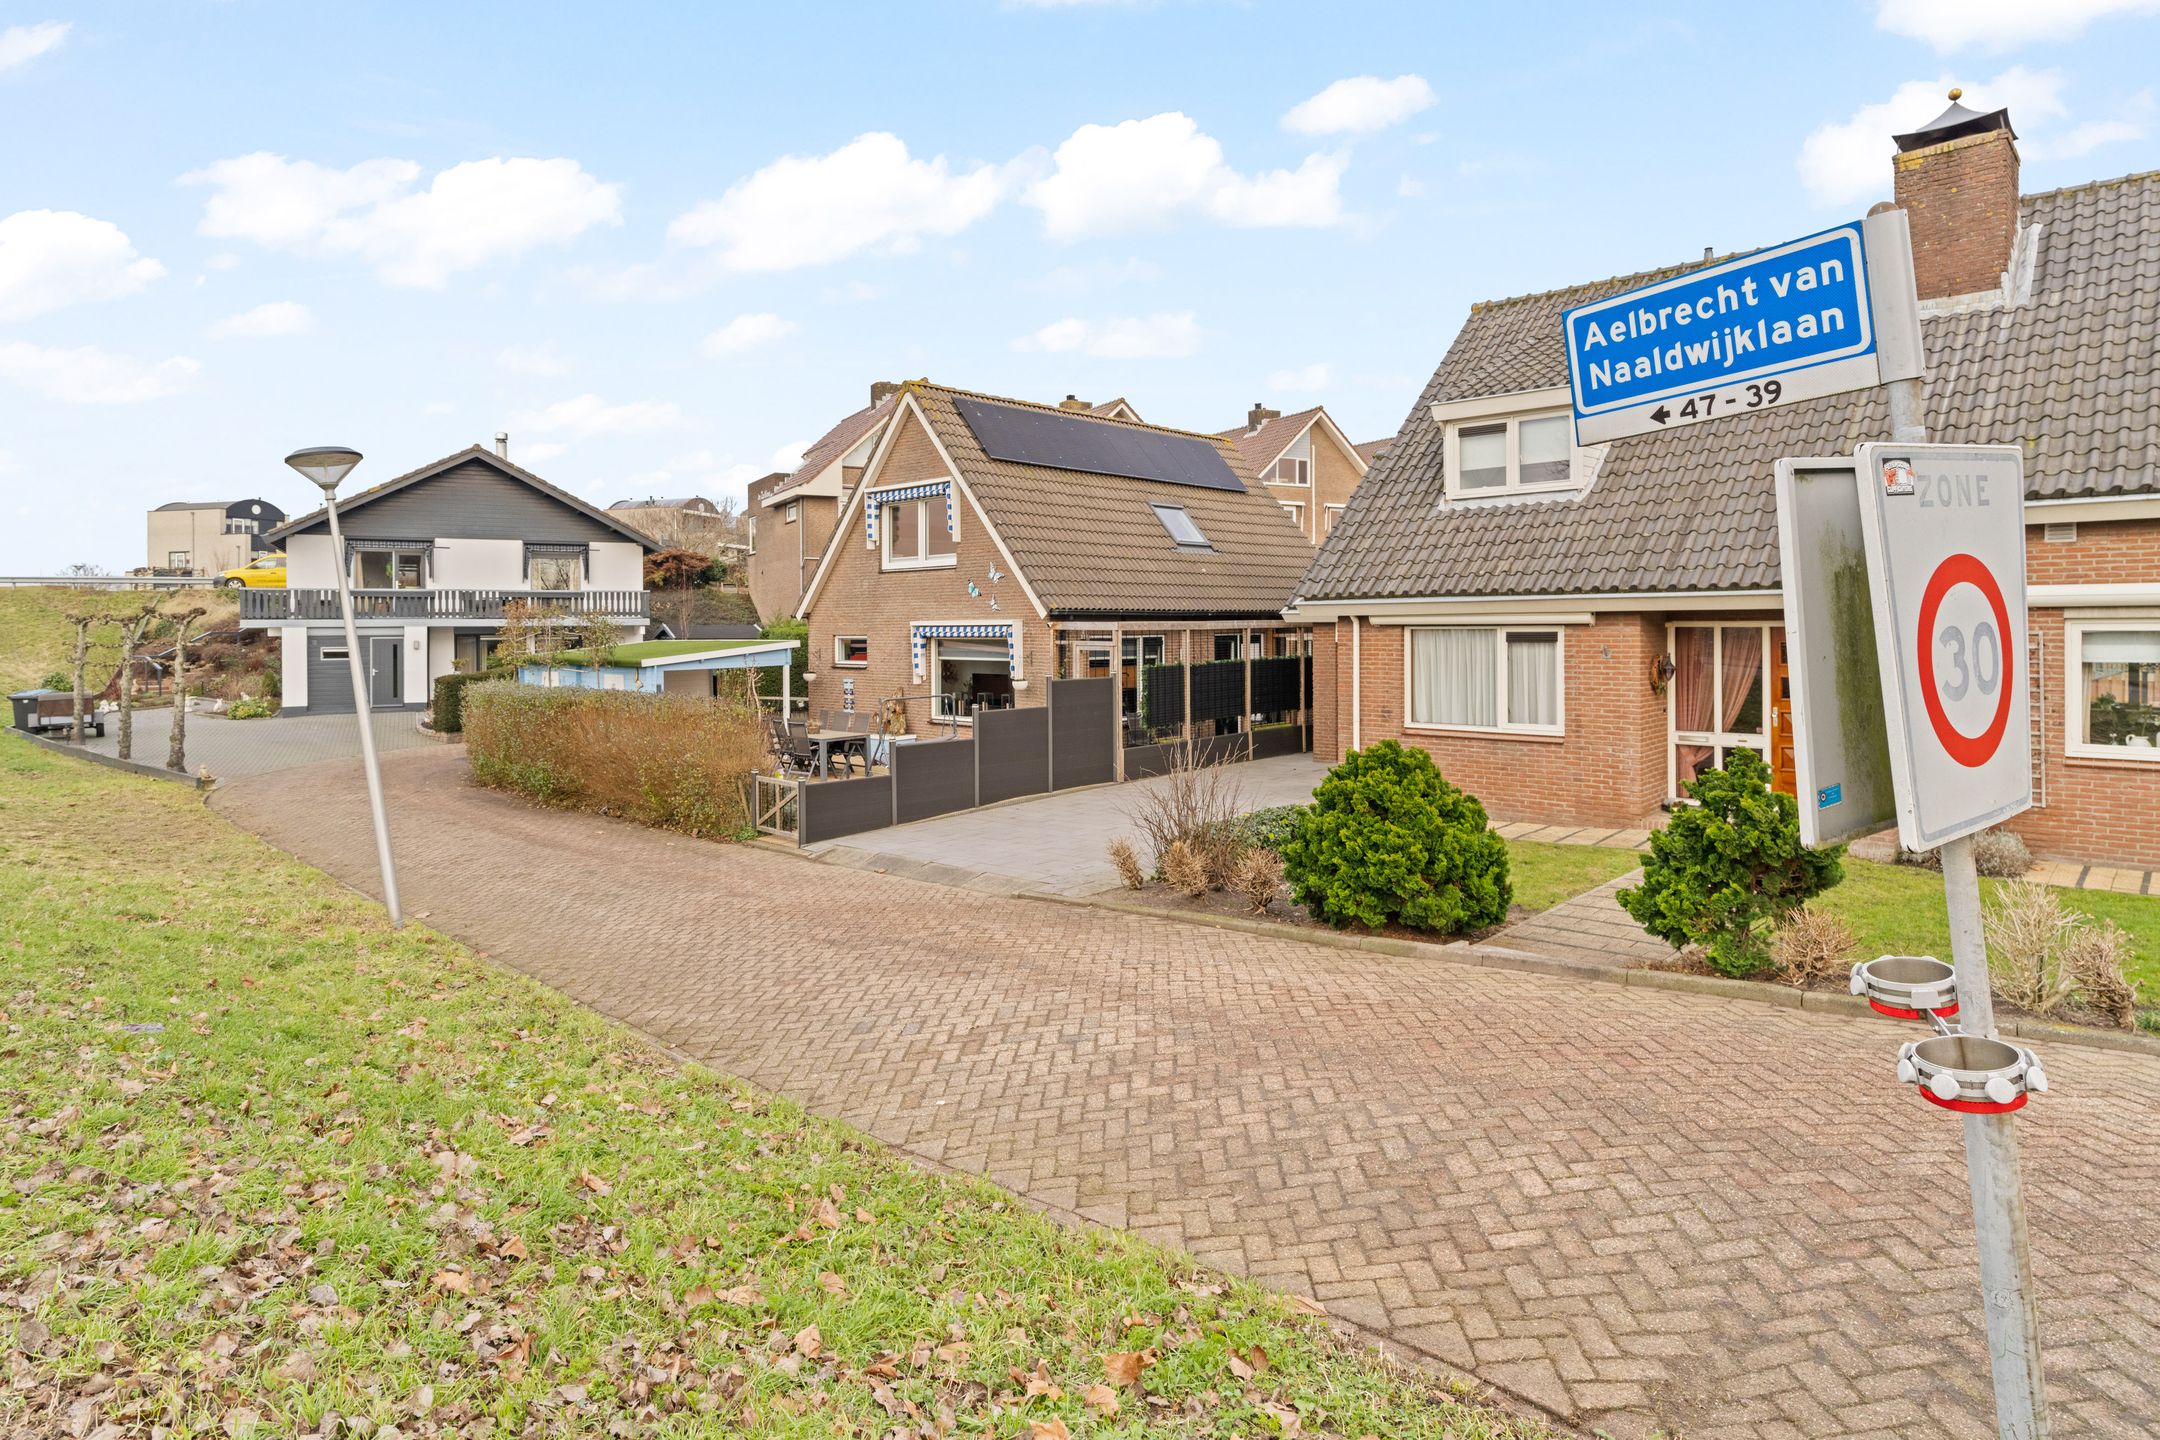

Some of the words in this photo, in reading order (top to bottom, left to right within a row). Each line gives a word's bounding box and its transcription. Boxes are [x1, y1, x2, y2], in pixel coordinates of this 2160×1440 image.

[1584, 276, 1759, 352] Aelbrecht
[1769, 259, 1844, 299] van
[1589, 307, 1845, 390] Naaldwijklaan
[1679, 394, 1716, 419] 47
[1745, 380, 1782, 408] 39
[1918, 474, 1991, 508] ZONE
[1938, 621, 1999, 702] 30
